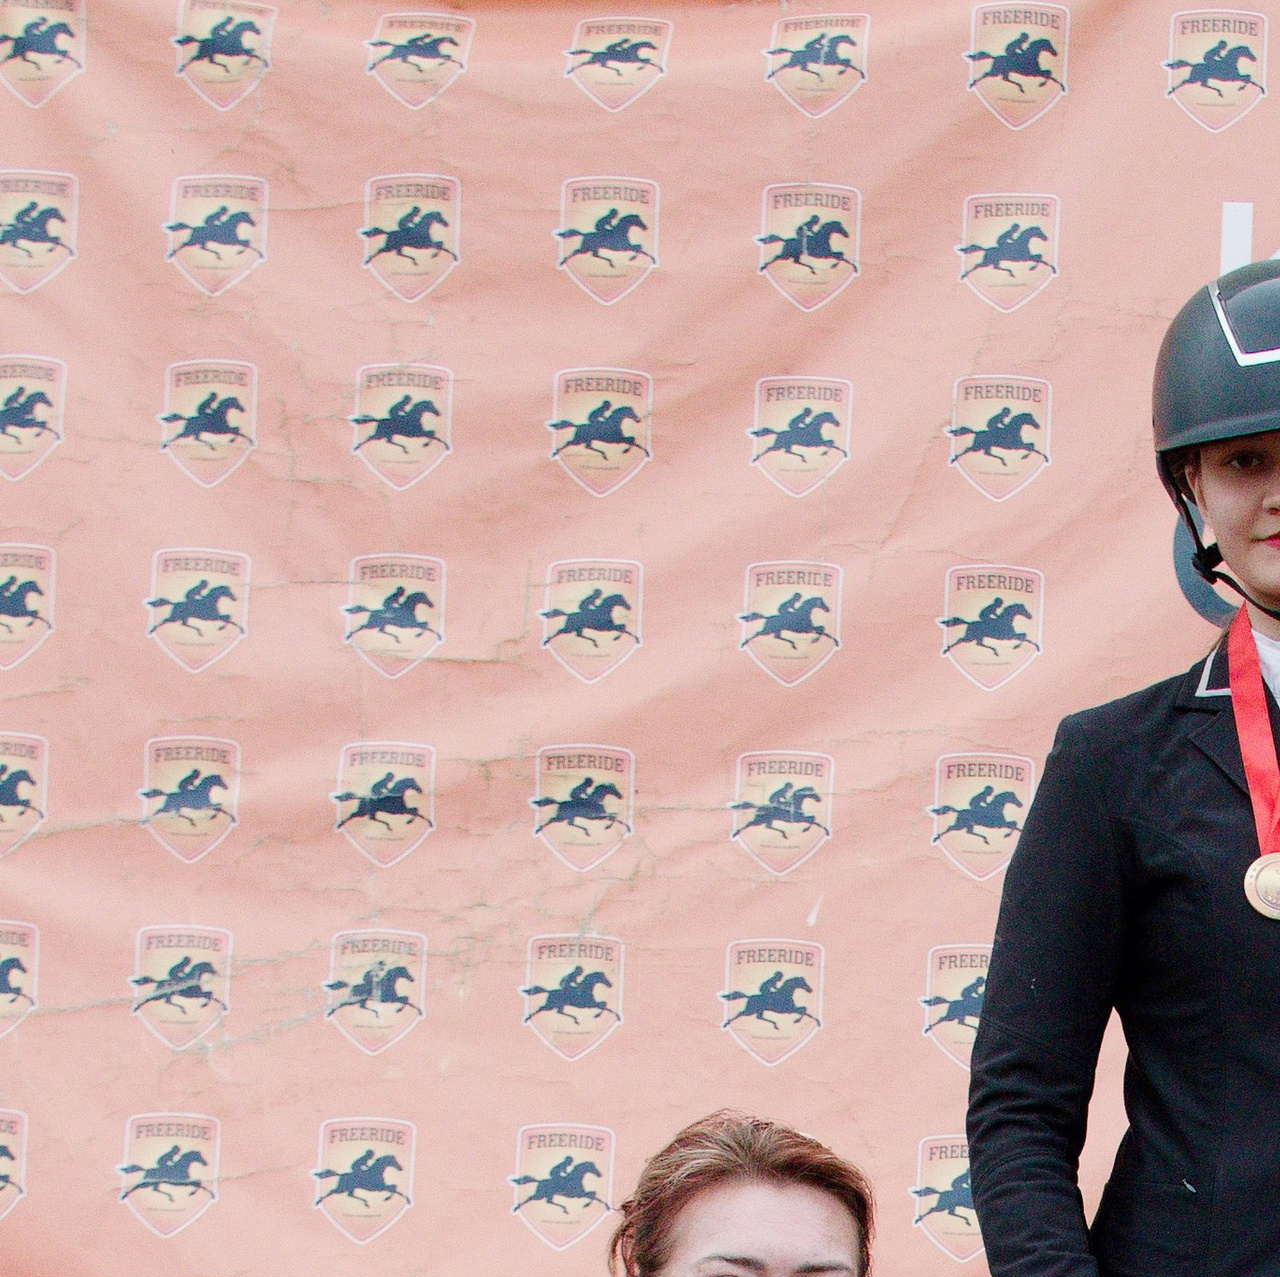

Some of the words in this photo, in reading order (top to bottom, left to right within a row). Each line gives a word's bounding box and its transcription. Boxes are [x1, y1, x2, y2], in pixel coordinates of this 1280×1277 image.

[981, 11, 1060, 30] FREERIDE
[1180, 18, 1259, 37] FREERIDE
[375, 184, 451, 201] FREERIDE
[571, 186, 649, 204] FREERIDE
[773, 193, 851, 211] FREERIDE
[974, 201, 1050, 219] FREERIDE
[564, 378, 642, 397] FREERIDE
[766, 386, 843, 403] FREERIDE
[964, 386, 1042, 404] FREERIDE
[360, 564, 437, 582] FREERIDE
[556, 568, 634, 586] FREERIDE
[955, 575, 1034, 593] FREERIDE
[154, 746, 231, 765] FREERIDE
[349, 752, 426, 769] FREERIDE
[546, 755, 624, 773] FREERIDE
[747, 761, 824, 778] FREERIDE
[946, 763, 1024, 782] FREERIDE
[537, 944, 615, 962] FREERIDE
[736, 949, 814, 966] FREERIDE
[938, 955, 989, 971] FREER
[135, 1123, 212, 1141] FREERIDE
[330, 1128, 406, 1146] FREERIDE
[527, 1134, 605, 1152] FREERIDE
[928, 1144, 971, 1161] FREE
